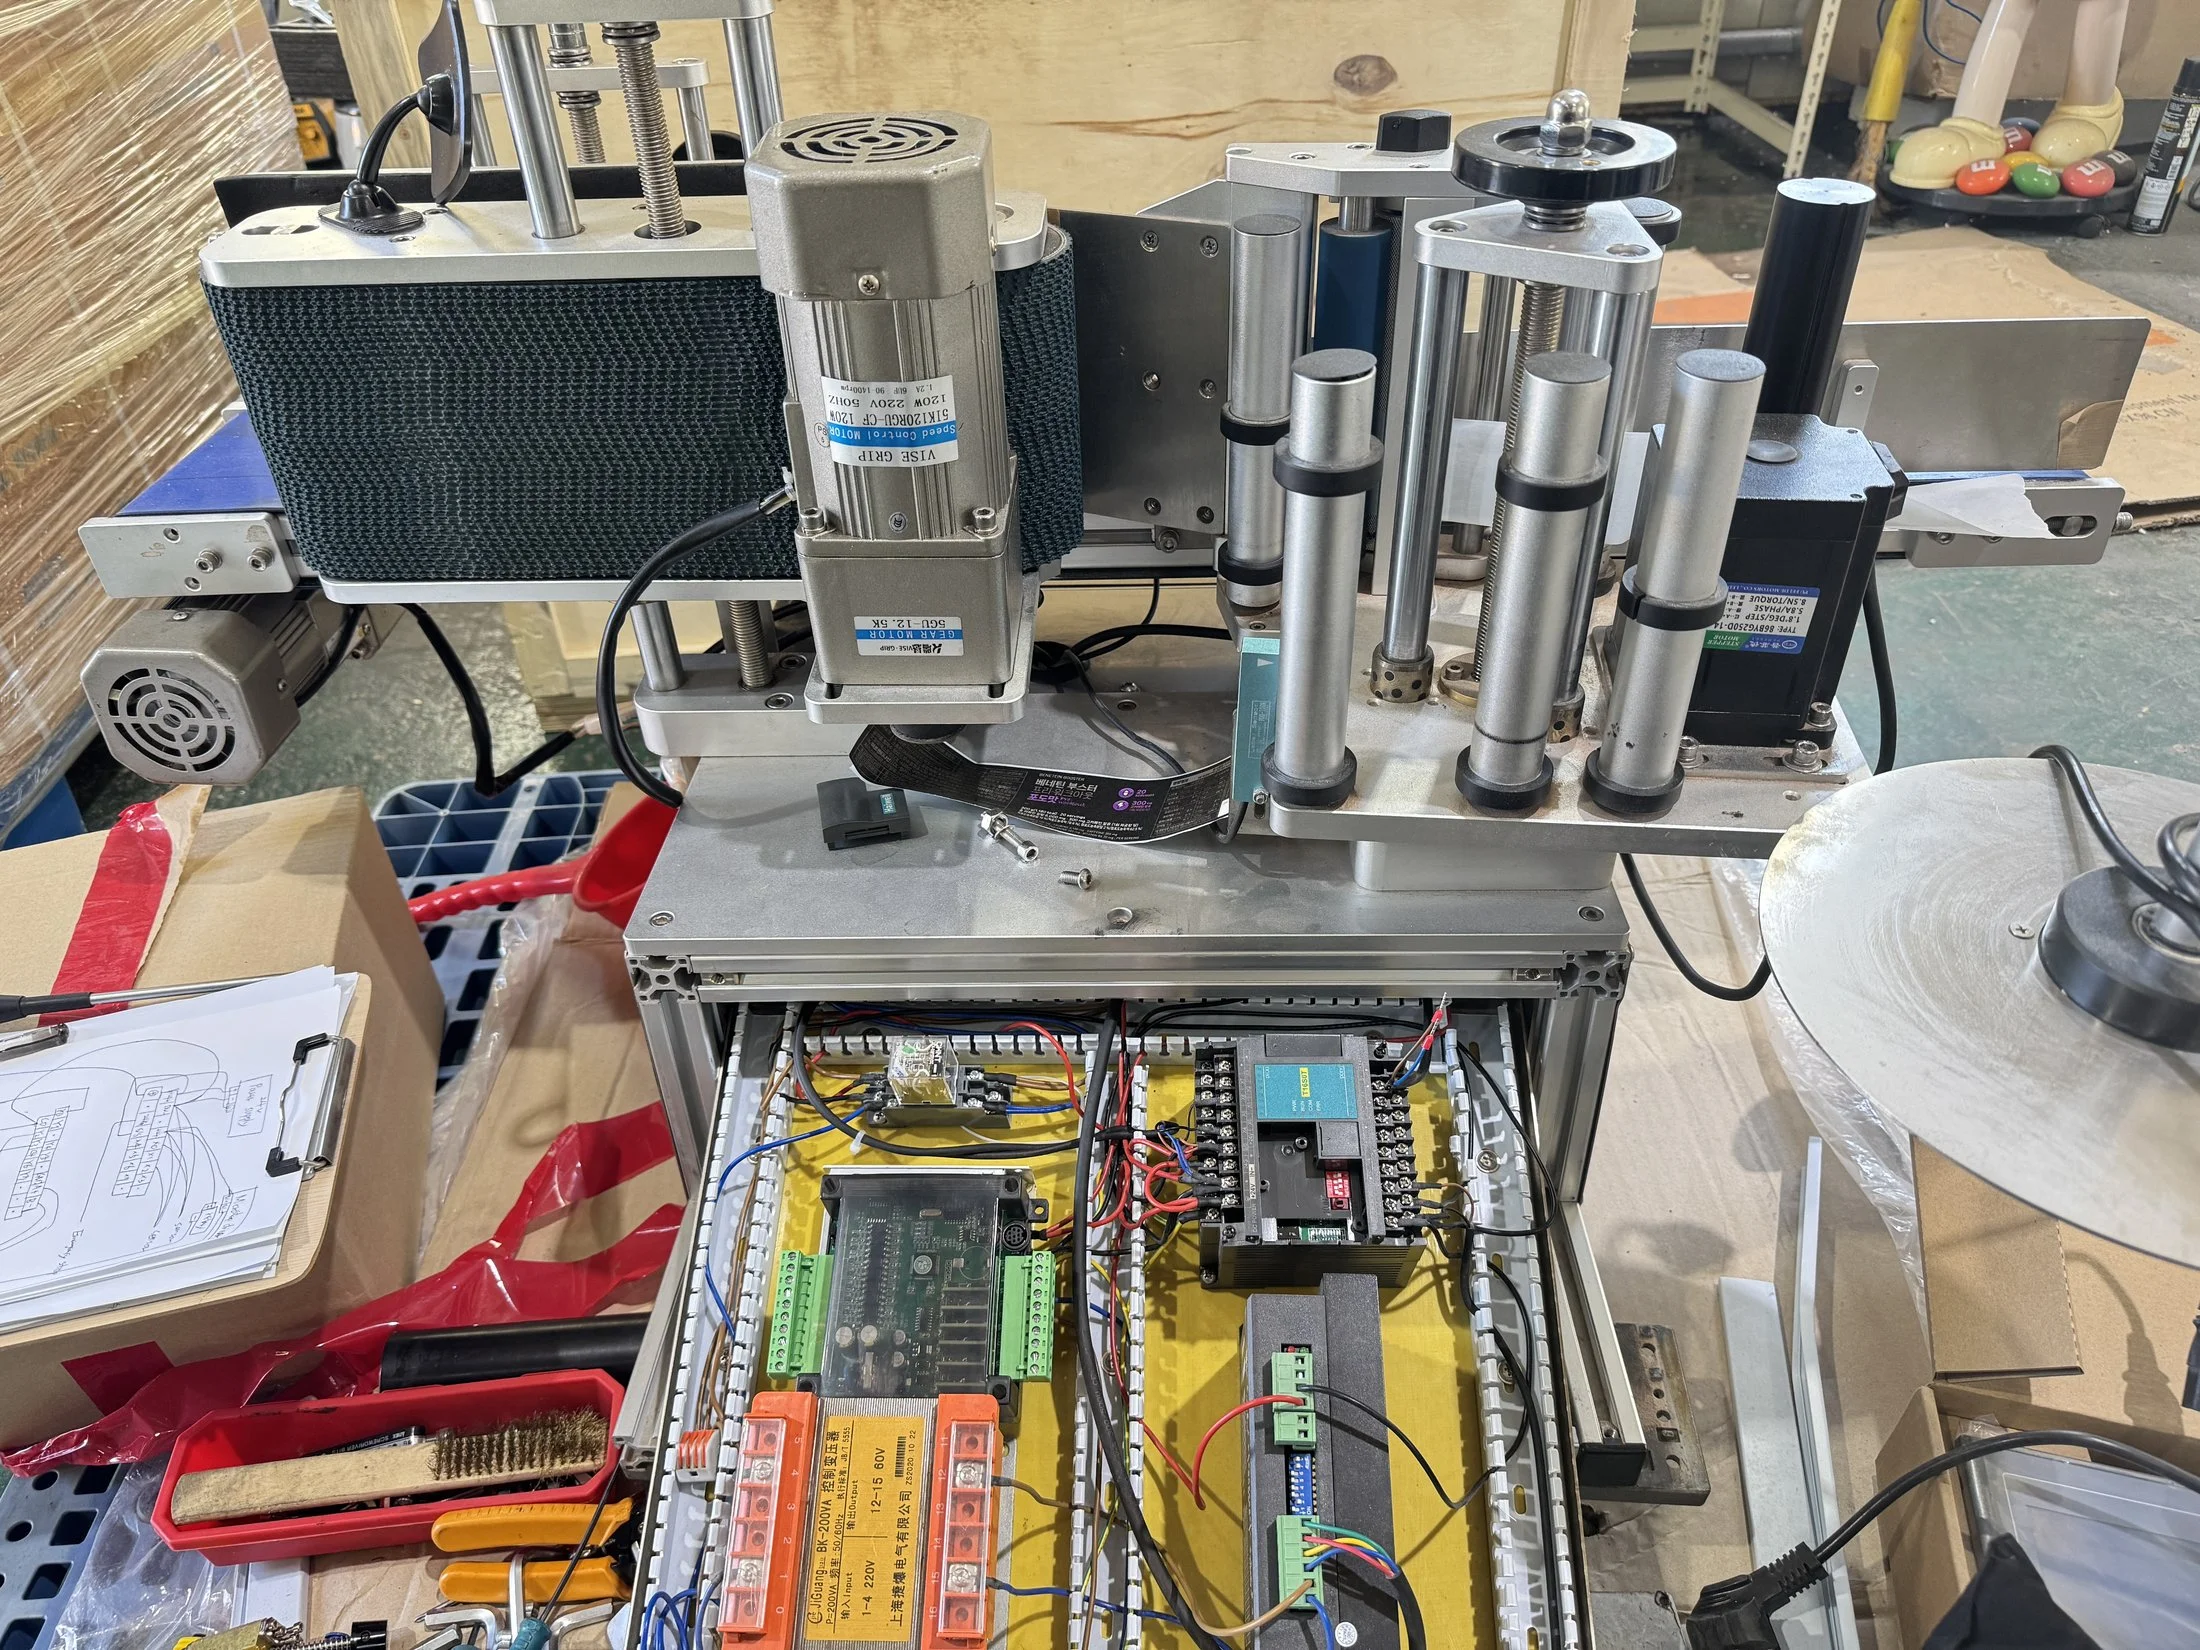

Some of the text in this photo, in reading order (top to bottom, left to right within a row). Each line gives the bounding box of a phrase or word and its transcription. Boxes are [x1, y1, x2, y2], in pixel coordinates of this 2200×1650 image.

[828, 394, 946, 408] 120W 220V 50HZ
[829, 410, 854, 424] 120W
[829, 424, 955, 440] Speed Control MOTOR
[858, 449, 936, 462] VISE GRIP
[1749, 595, 1806, 604] 8.5N/TORQUE
[1754, 605, 1803, 614] 5.8A/PHASE
[1777, 625, 1796, 633] TYPE:
[1067, 782, 1098, 792] 부스터
[1027, 793, 1059, 803] 포도맛
[940, 1436, 948, 1448] 11
[791, 1468, 800, 1477] 4
[938, 1468, 947, 1482] 12
[870, 1447, 886, 1514] 12-15 60V
[787, 1503, 796, 1511] 3
[936, 1503, 944, 1516] 13
[811, 1430, 840, 1609] JiGuang BK-200VA 控制变压器
[826, 1584, 837, 1625] P=200VA
[842, 1426, 851, 1443] 5555
[783, 1536, 792, 1545] 2
[933, 1537, 942, 1550] 14
[931, 1571, 940, 1584] 15
[862, 1560, 876, 1617] 1-4 220V
[776, 1606, 785, 1614] 0
[928, 1606, 937, 1620] 16
